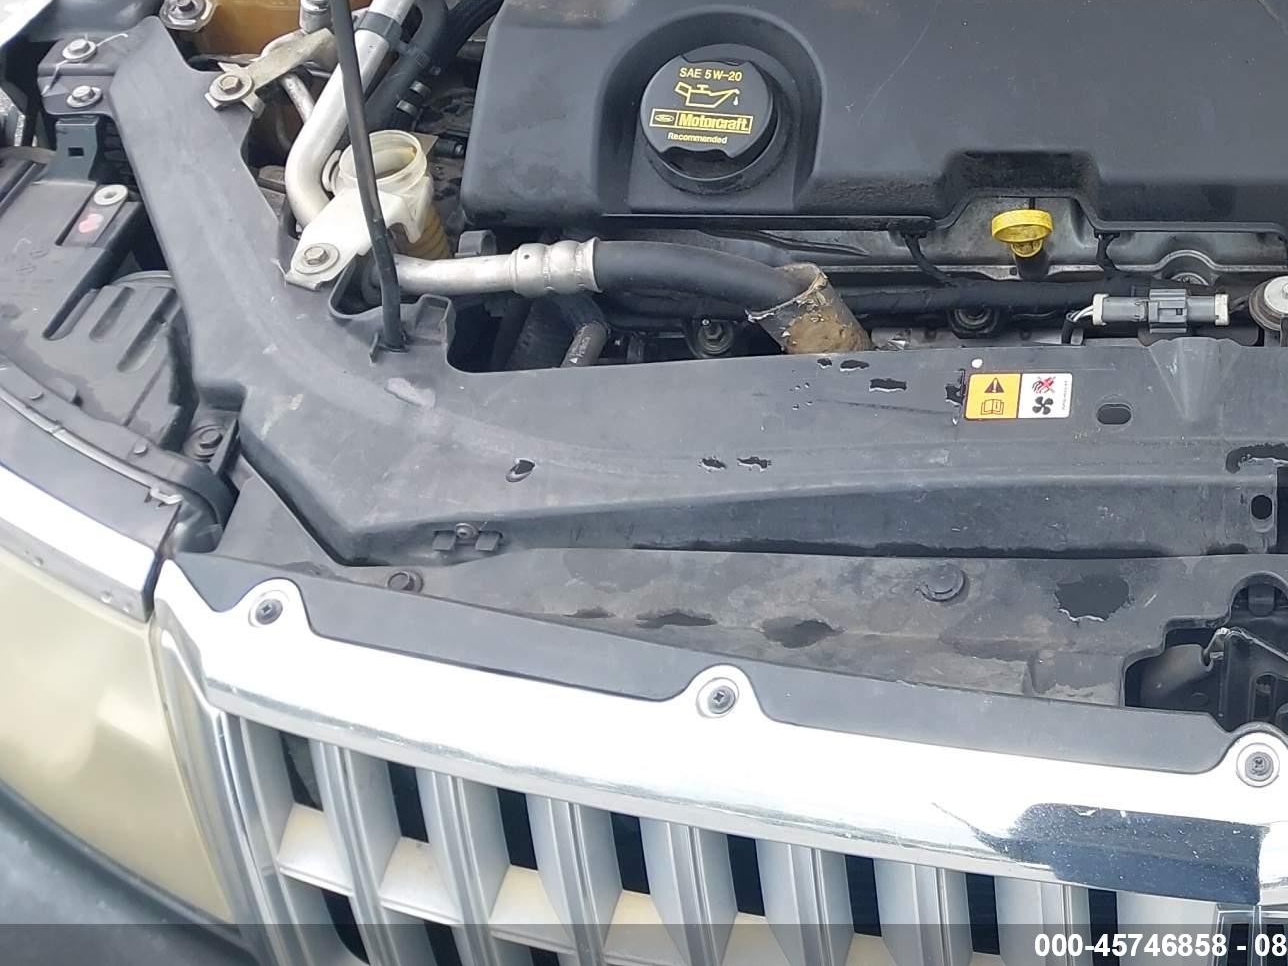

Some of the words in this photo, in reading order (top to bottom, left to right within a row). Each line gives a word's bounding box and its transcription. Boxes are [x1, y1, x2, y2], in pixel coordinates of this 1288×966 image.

[679, 67, 702, 79] SAE
[704, 69, 742, 82] 5W-20
[667, 132, 728, 144] Recommended
